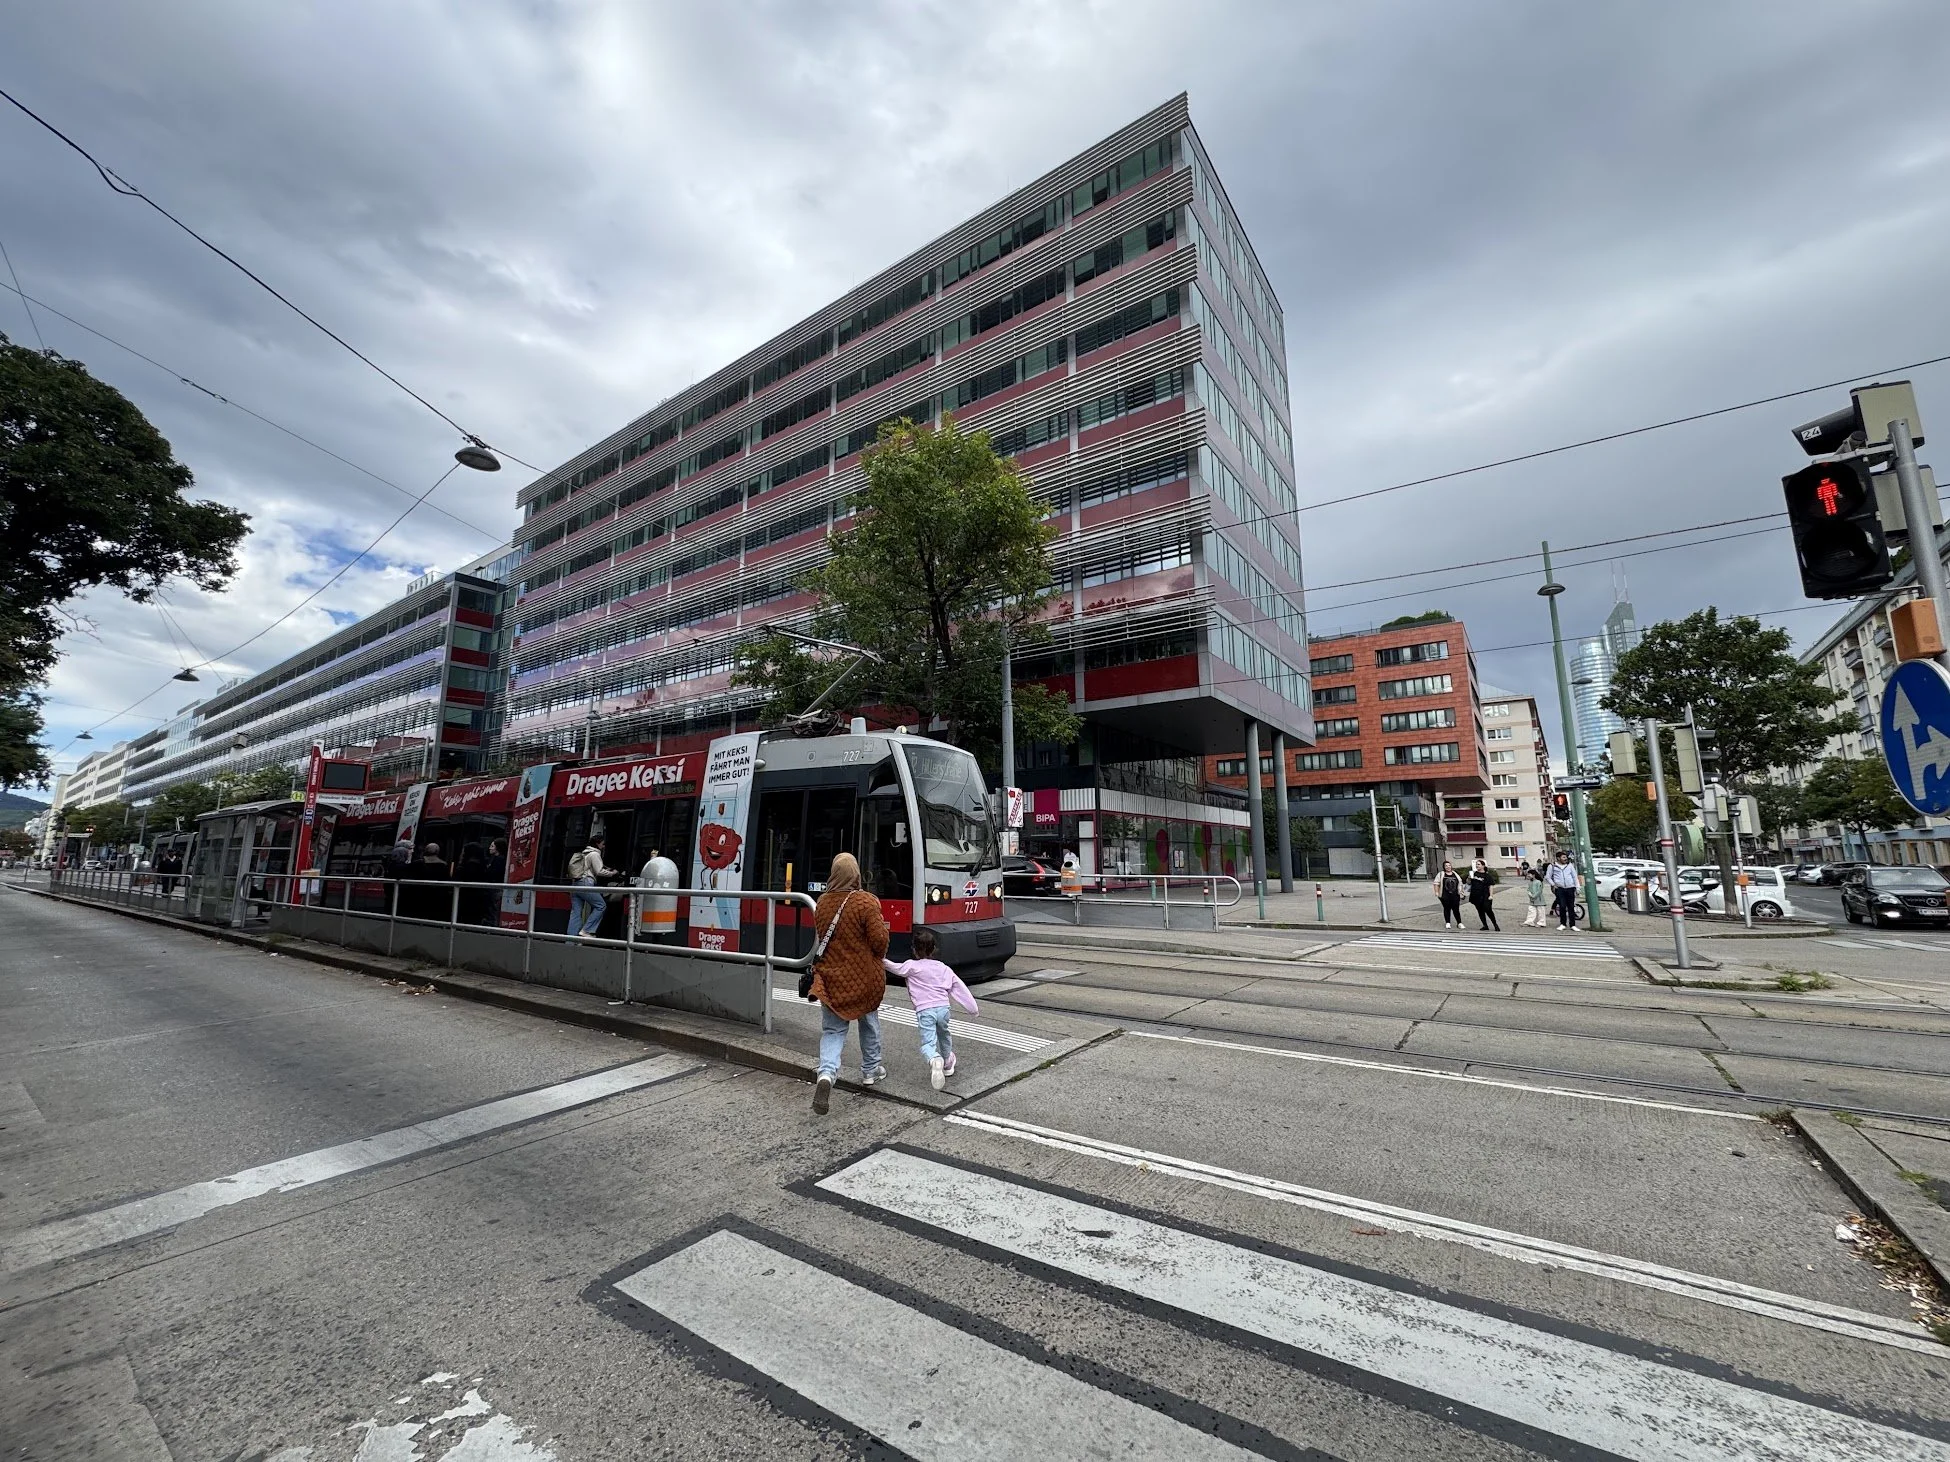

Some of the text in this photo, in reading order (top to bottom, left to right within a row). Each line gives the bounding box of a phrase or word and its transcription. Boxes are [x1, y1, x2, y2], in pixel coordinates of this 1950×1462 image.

[1803, 427, 1820, 439] 24
[714, 745, 748, 761] MIT KEKSI
[843, 750, 861, 762] 727
[710, 756, 751, 774] FÄHRT MAN
[566, 757, 686, 798] Dragee Keksi
[708, 768, 750, 784] IMMER GUT!
[346, 795, 402, 820] Dragee Keksi
[513, 811, 539, 830] Dragee
[1035, 813, 1056, 823] BIPA
[514, 821, 536, 840] Keksi
[964, 900, 979, 914] 727
[698, 931, 726, 943] Dragee
[701, 941, 722, 951] Keksi
